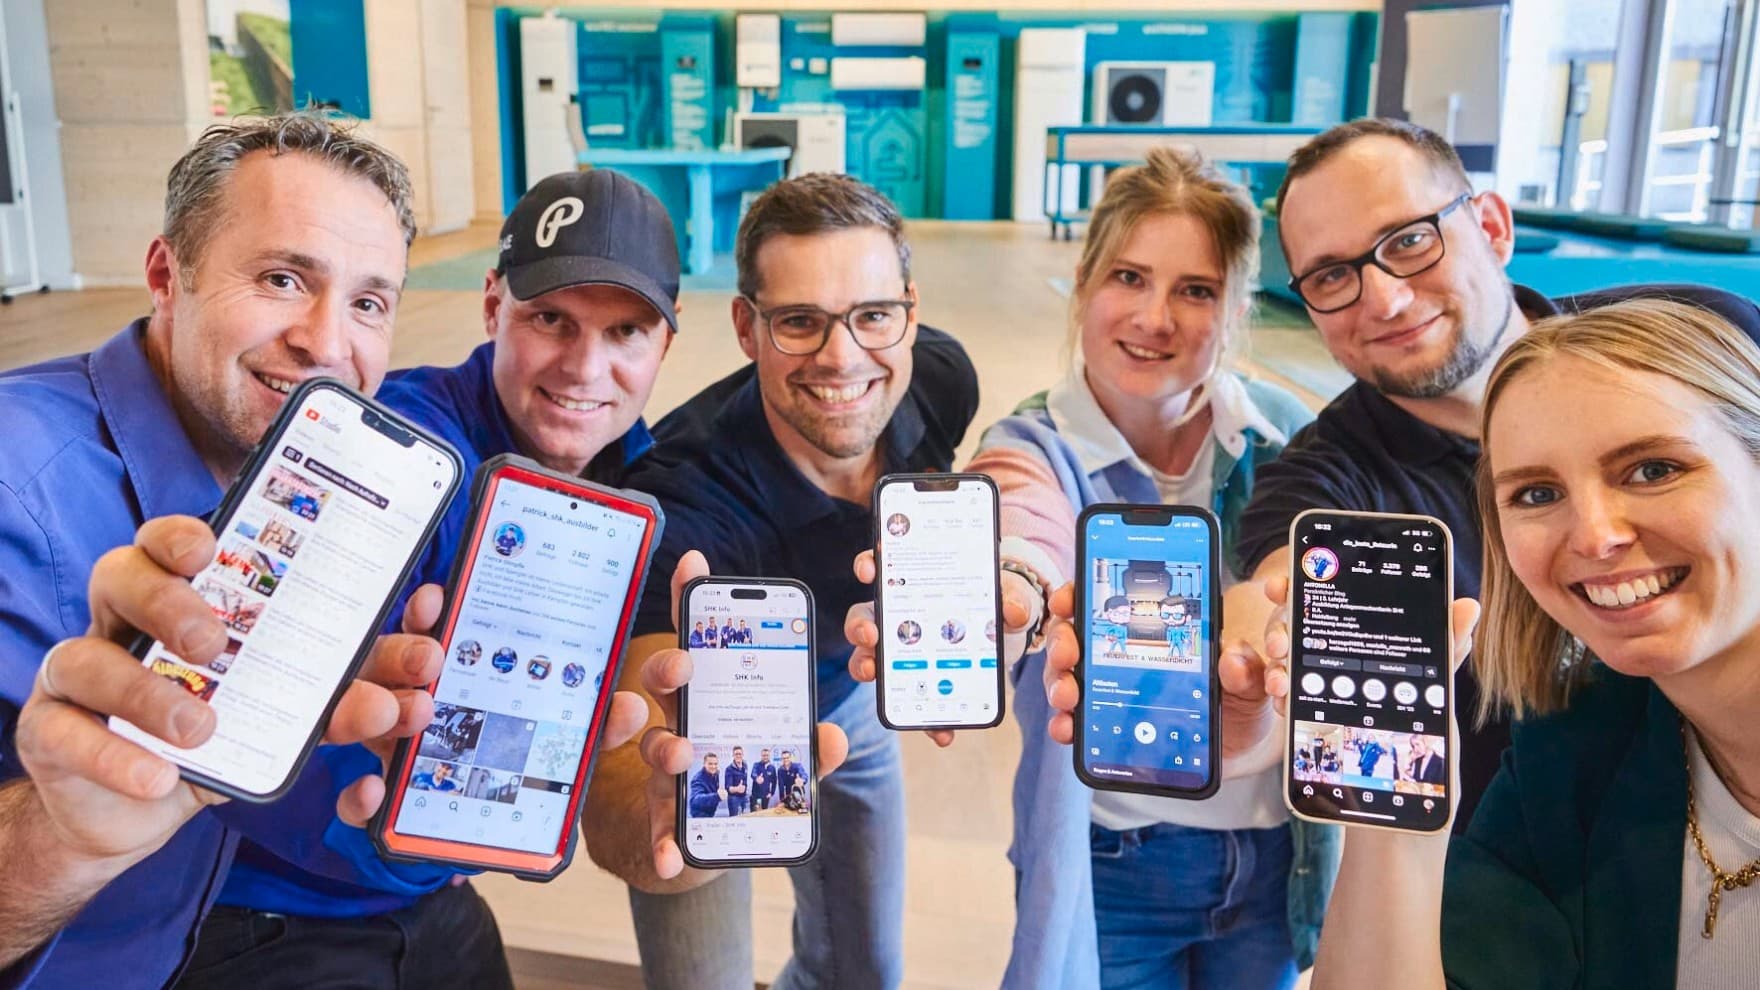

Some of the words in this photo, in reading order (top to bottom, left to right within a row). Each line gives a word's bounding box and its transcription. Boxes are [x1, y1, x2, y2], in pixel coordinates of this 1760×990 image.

[536, 196, 584, 248] P
[522, 506, 599, 532] patrick_shk_ausbilder
[543, 542, 556, 551] 683
[607, 559, 619, 568] 900
[1147, 655, 1193, 664] WASSERDICHT
[735, 673, 749, 681] SHK
[750, 673, 764, 681] Info
